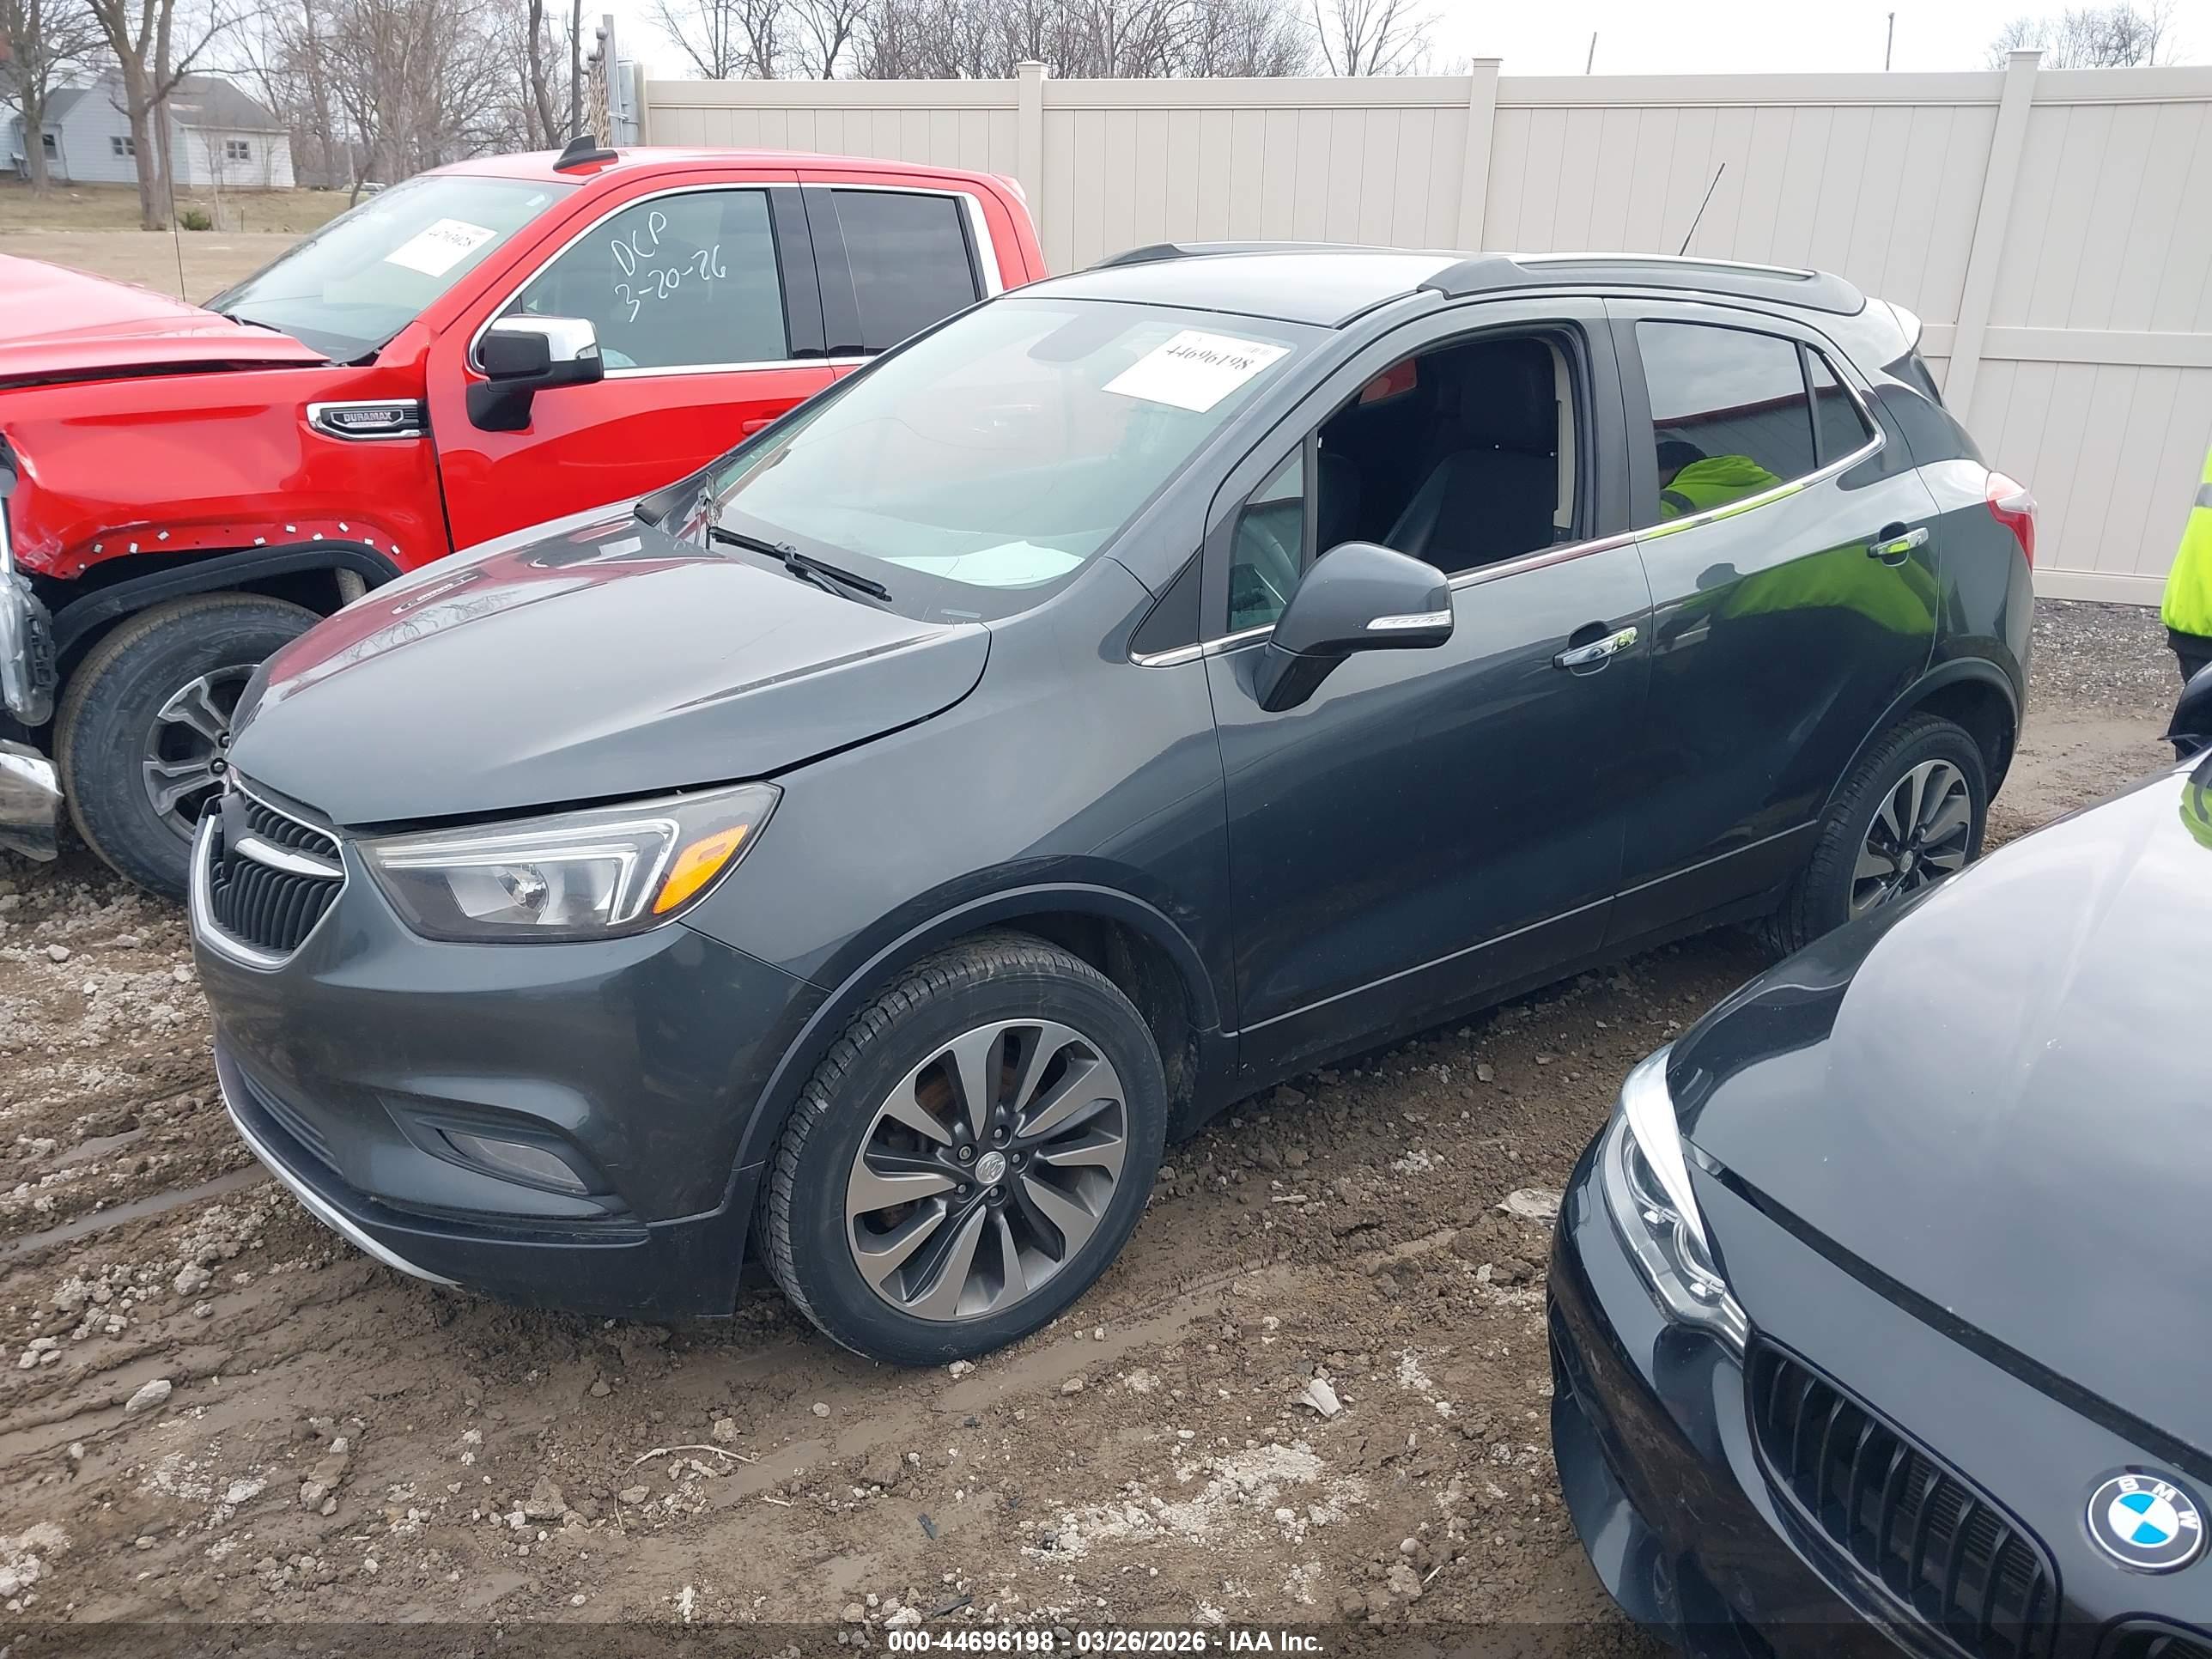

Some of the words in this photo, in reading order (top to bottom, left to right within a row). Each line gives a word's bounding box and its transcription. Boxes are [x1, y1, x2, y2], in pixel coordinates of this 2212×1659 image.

[611, 211, 667, 276] DCP
[614, 244, 727, 323] 3-20-26
[1166, 343, 1255, 371] 44696198
[343, 411, 392, 422] DURAMAX
[2118, 1476, 2199, 1530] BMW
